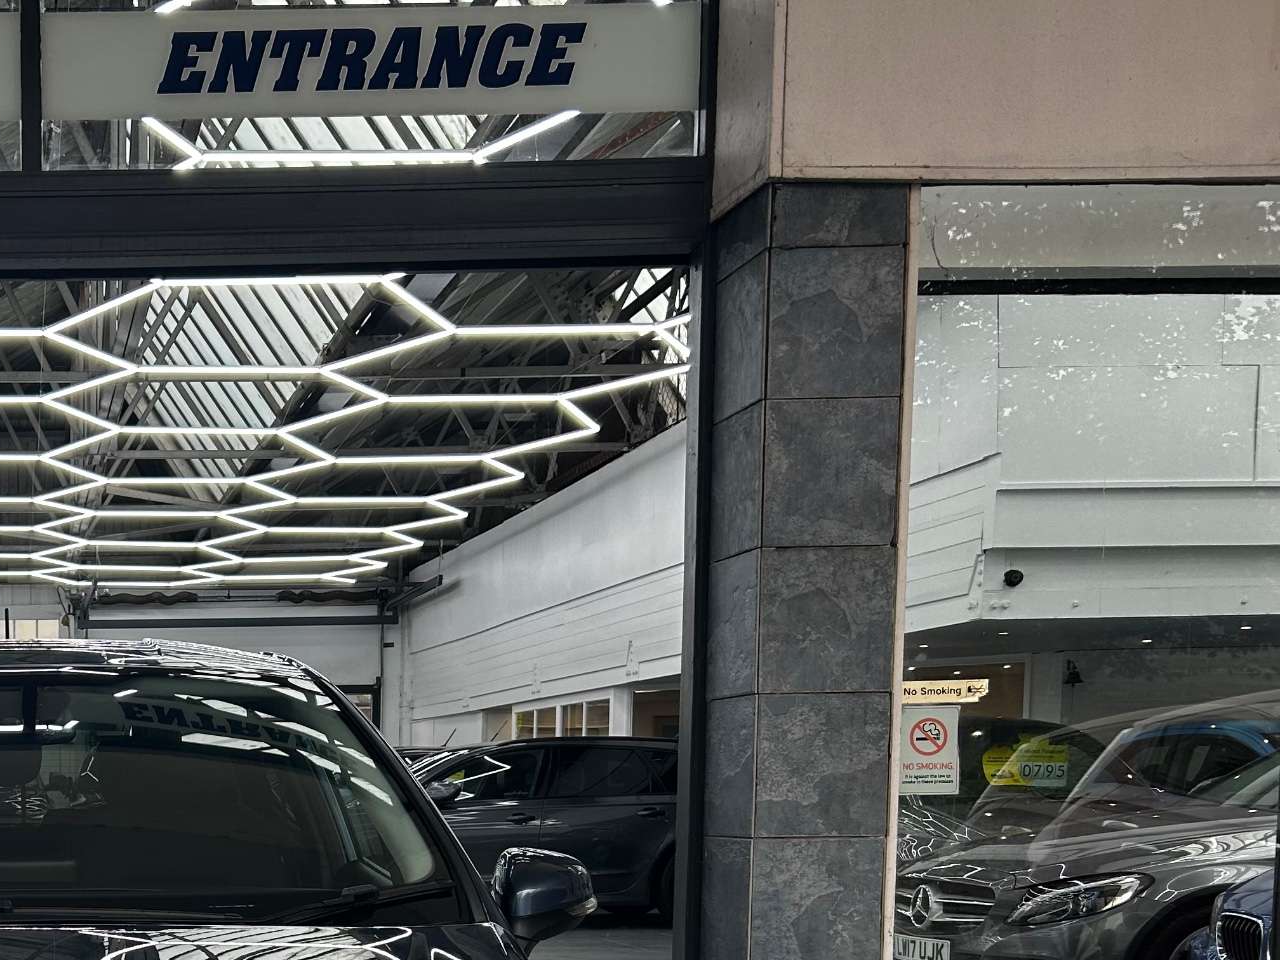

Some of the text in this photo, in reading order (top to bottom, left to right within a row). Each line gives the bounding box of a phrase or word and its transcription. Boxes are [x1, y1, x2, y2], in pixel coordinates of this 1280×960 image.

[157, 22, 587, 94] ENTRANCE
[903, 686, 962, 697] No Smoking
[902, 762, 915, 770] NO
